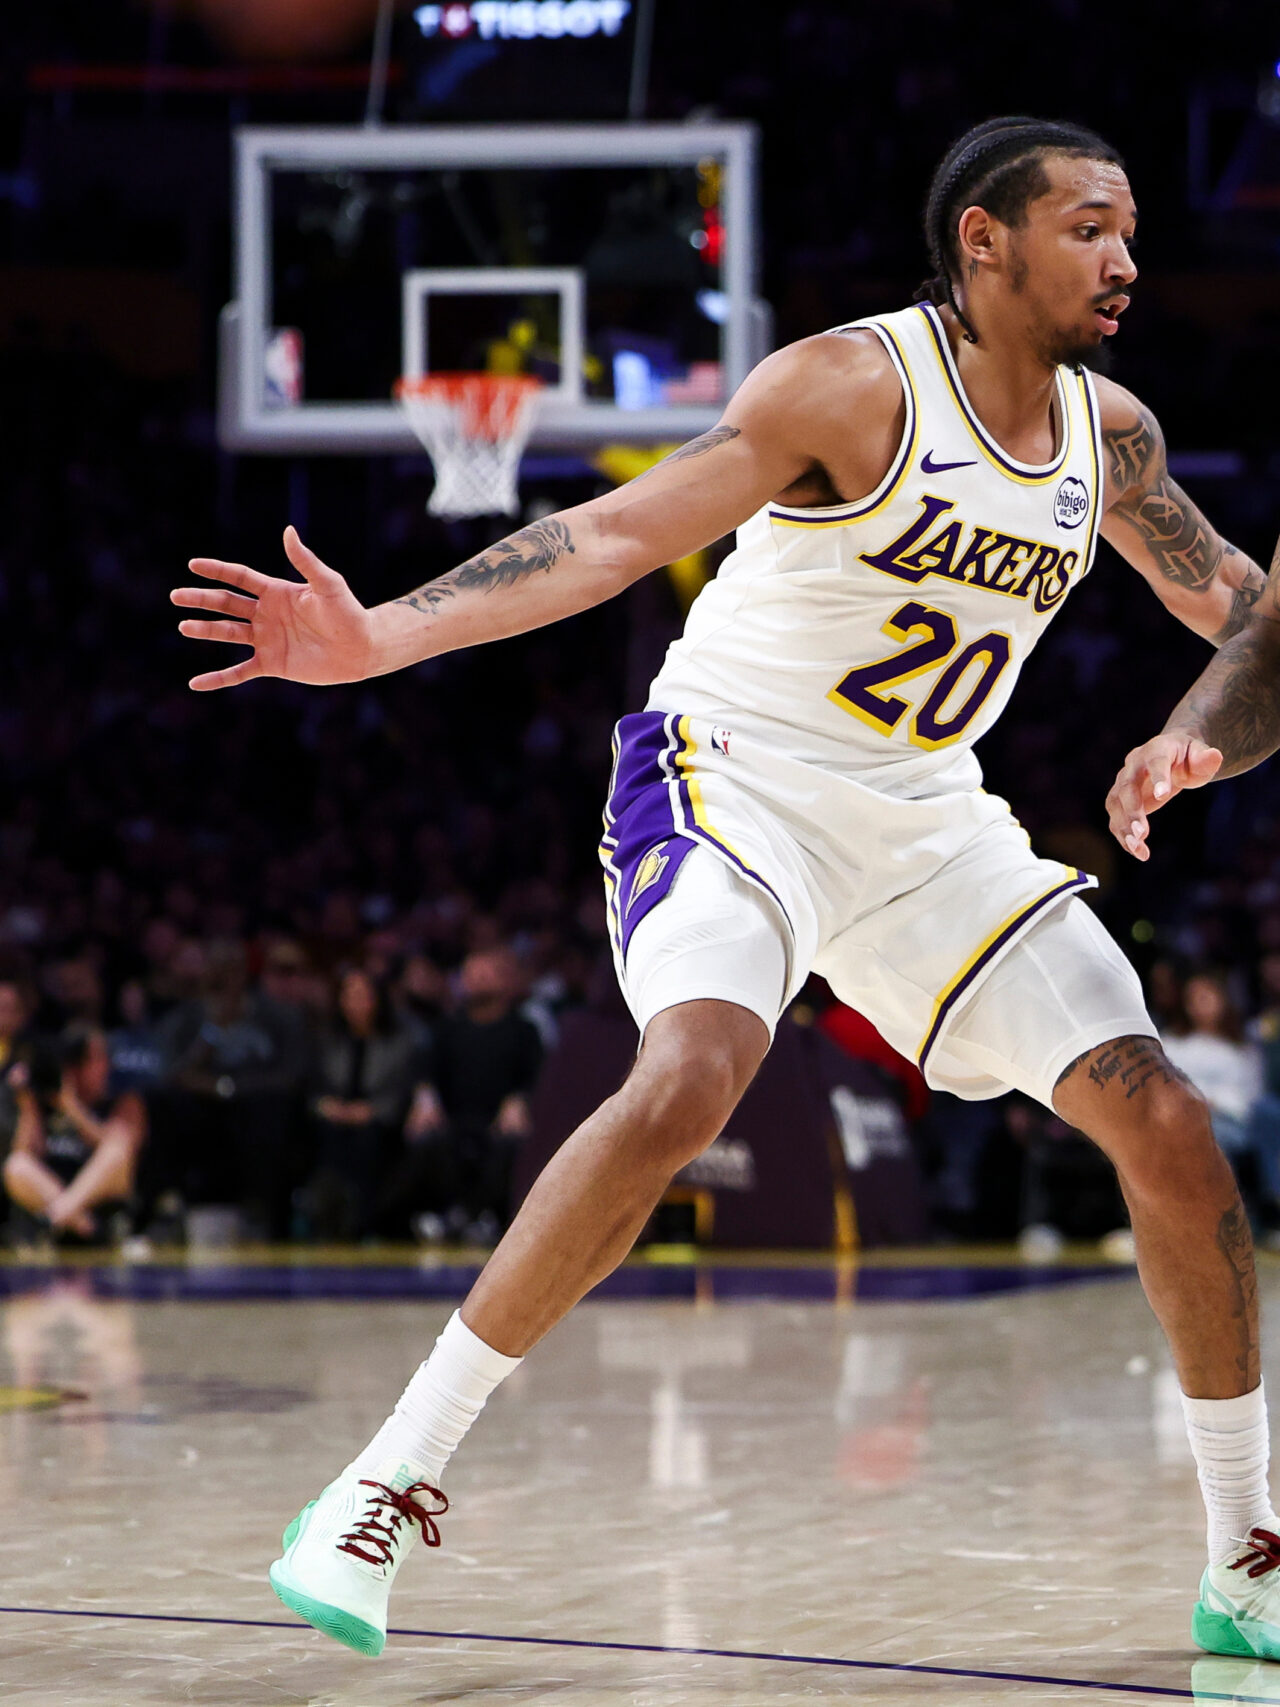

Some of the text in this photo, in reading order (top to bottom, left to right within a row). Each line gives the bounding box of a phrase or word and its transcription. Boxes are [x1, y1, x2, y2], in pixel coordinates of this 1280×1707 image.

[470, 0, 631, 39] TISSOT
[1057, 490, 1086, 515] bibigo
[855, 493, 1080, 615] LAKERS
[825, 599, 1012, 752] 20
